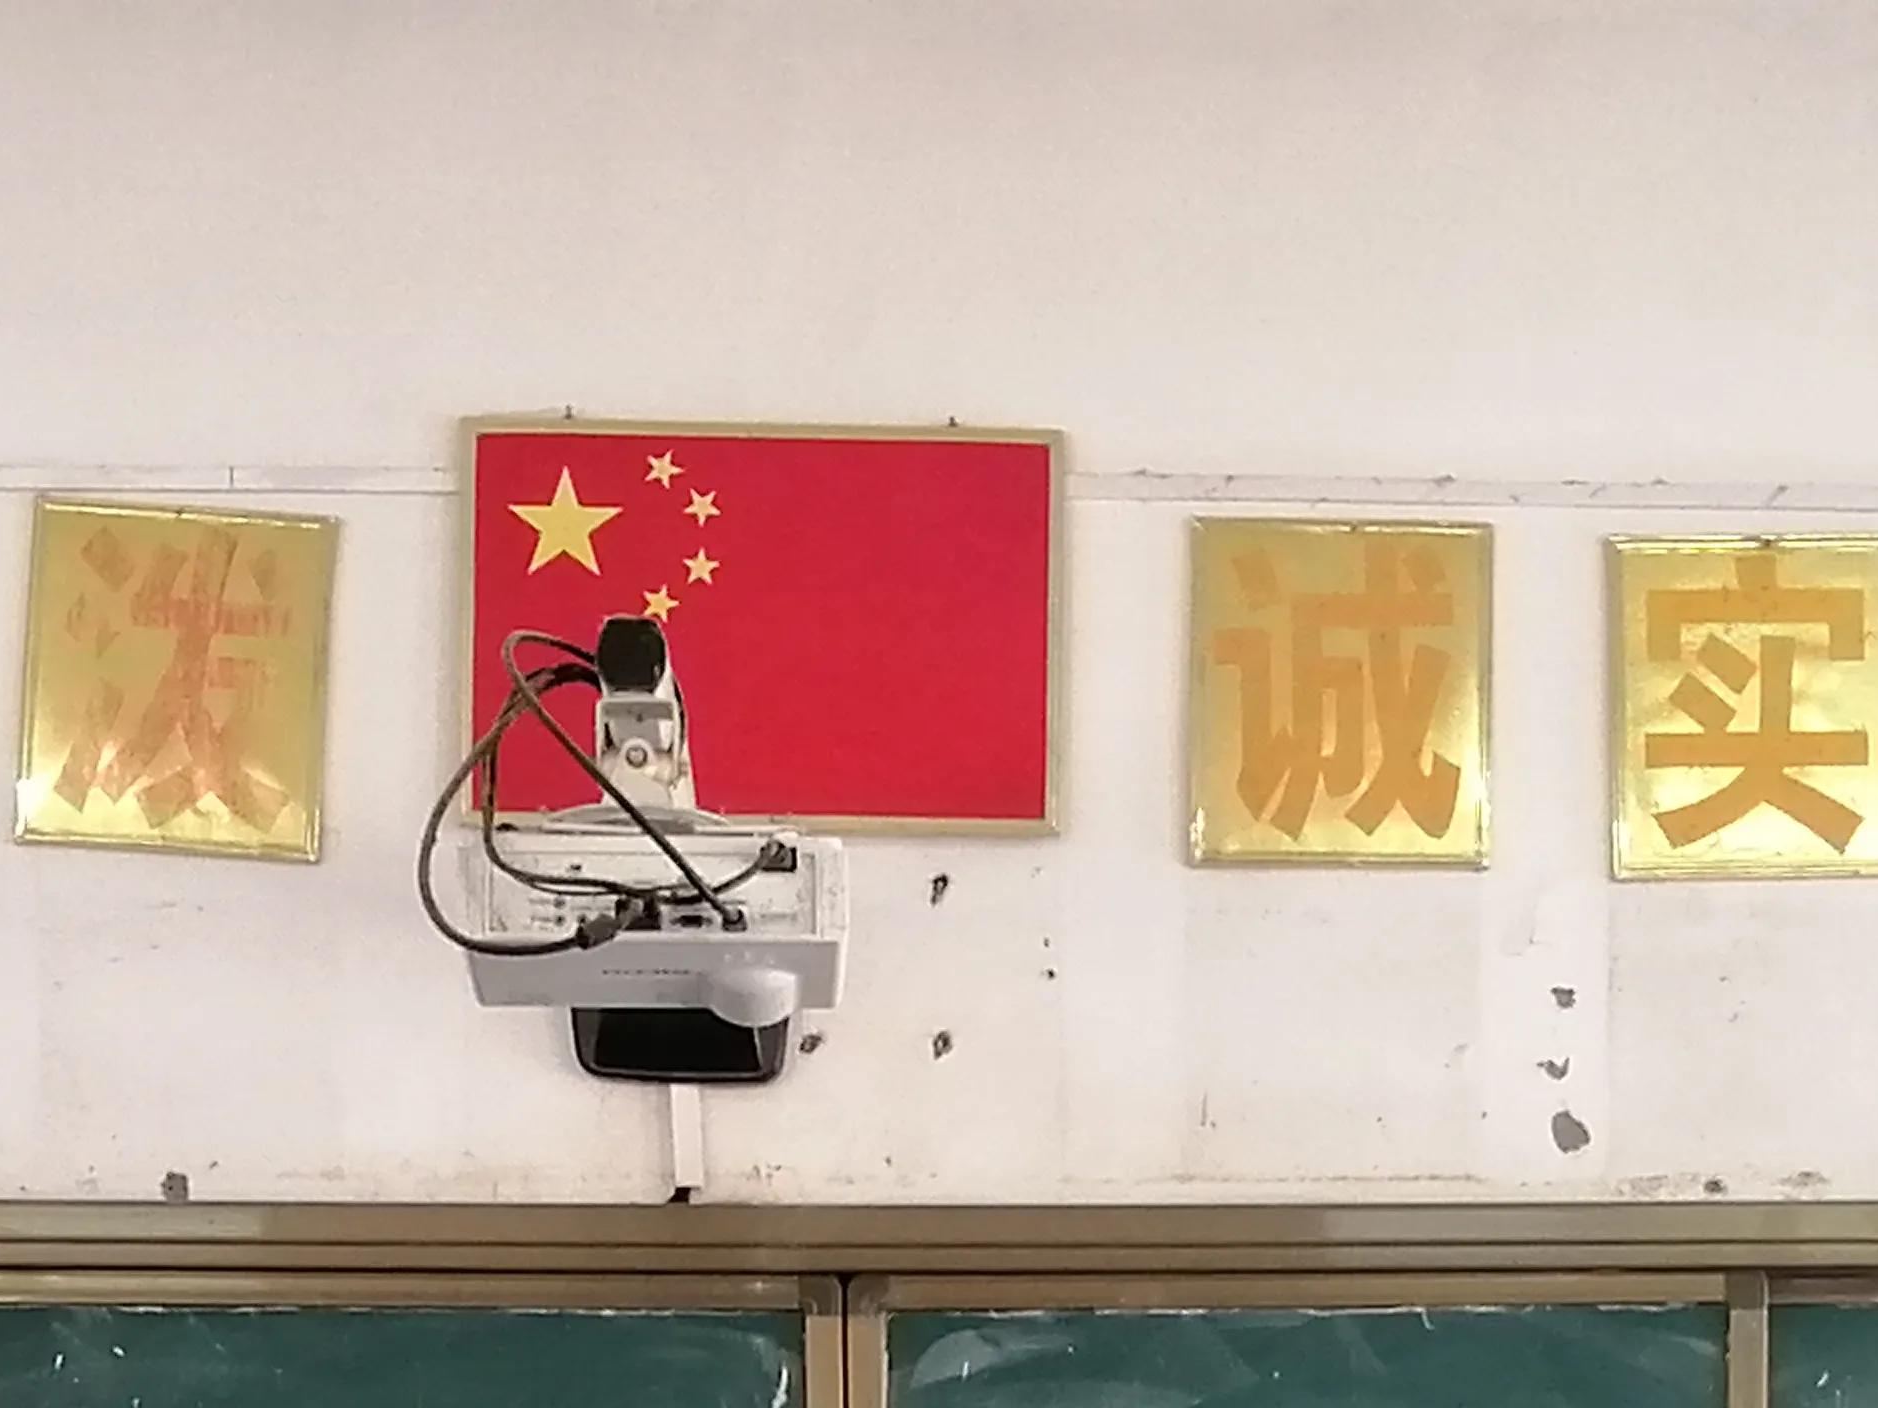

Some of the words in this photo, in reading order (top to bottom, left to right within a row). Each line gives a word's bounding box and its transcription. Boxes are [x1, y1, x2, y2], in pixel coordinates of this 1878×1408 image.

[53, 524, 291, 834] 泼
[1215, 547, 1461, 843] 诚
[1643, 554, 1870, 850] 实
